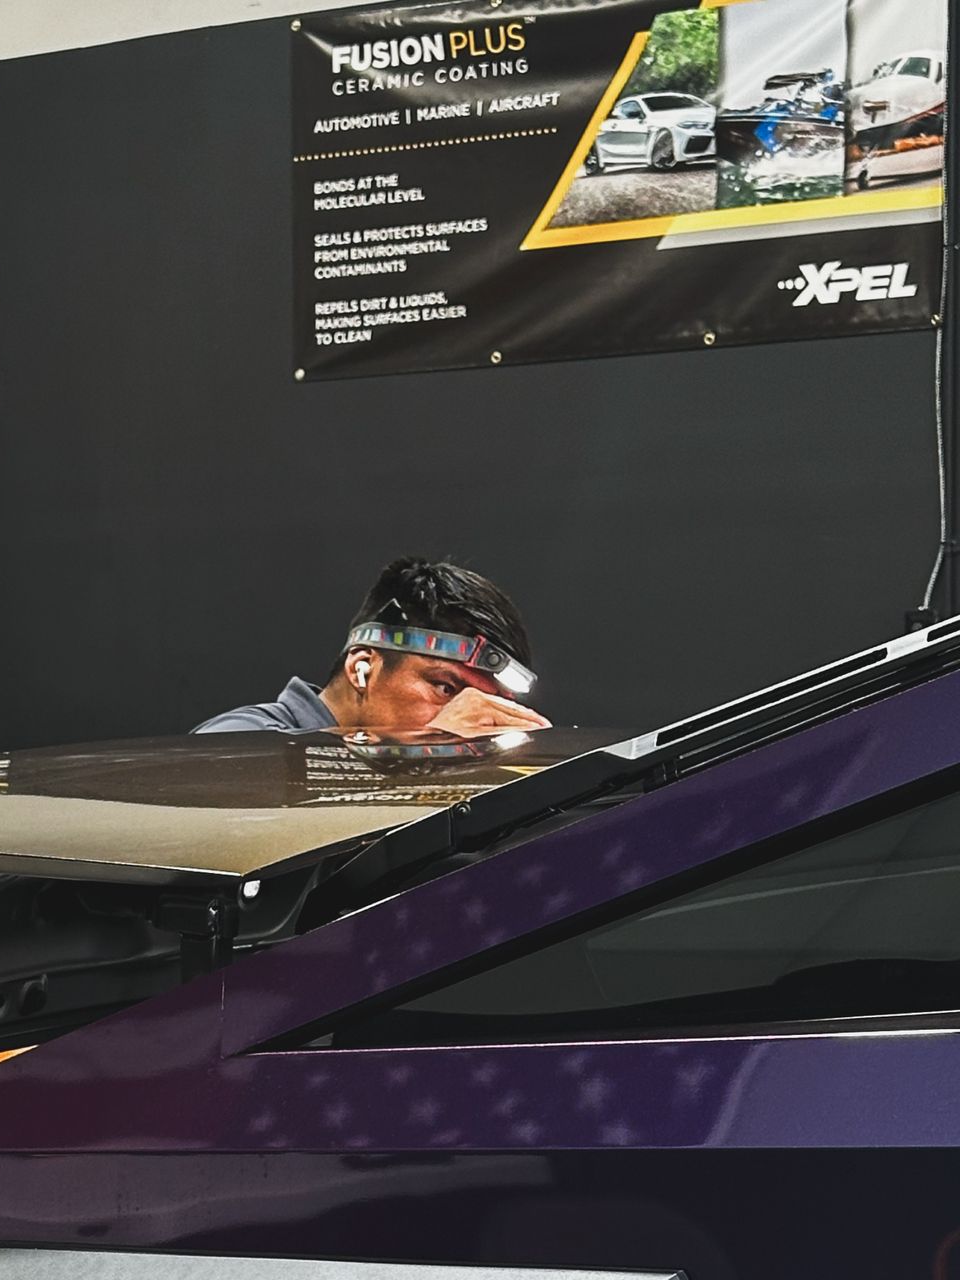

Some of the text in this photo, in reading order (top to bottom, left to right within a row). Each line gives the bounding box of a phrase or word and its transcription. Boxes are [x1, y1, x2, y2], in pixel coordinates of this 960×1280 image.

[331, 23, 526, 74] FUSION PLUS
[332, 59, 529, 96] CERAMIC COATING
[313, 110, 400, 134] AUTOMOTIVE
[416, 102, 470, 122] MARINE
[488, 91, 561, 114] AIRCRAFT
[313, 173, 399, 195] BONDS AT THE
[313, 188, 426, 211] MOLECULAR LEVEL
[313, 217, 488, 247] SEALS & PROTECTS SURFACES
[313, 239, 451, 263] FROM ENVIRONMENTAL
[313, 259, 407, 280] CONTAMINANTS
[792, 261, 918, 307] XPEL
[314, 291, 448, 315] REPELS DIRT & LIQUIDS,
[315, 305, 467, 330] MAKING SURFACES EASIER
[316, 329, 372, 345] TO CLEAN
